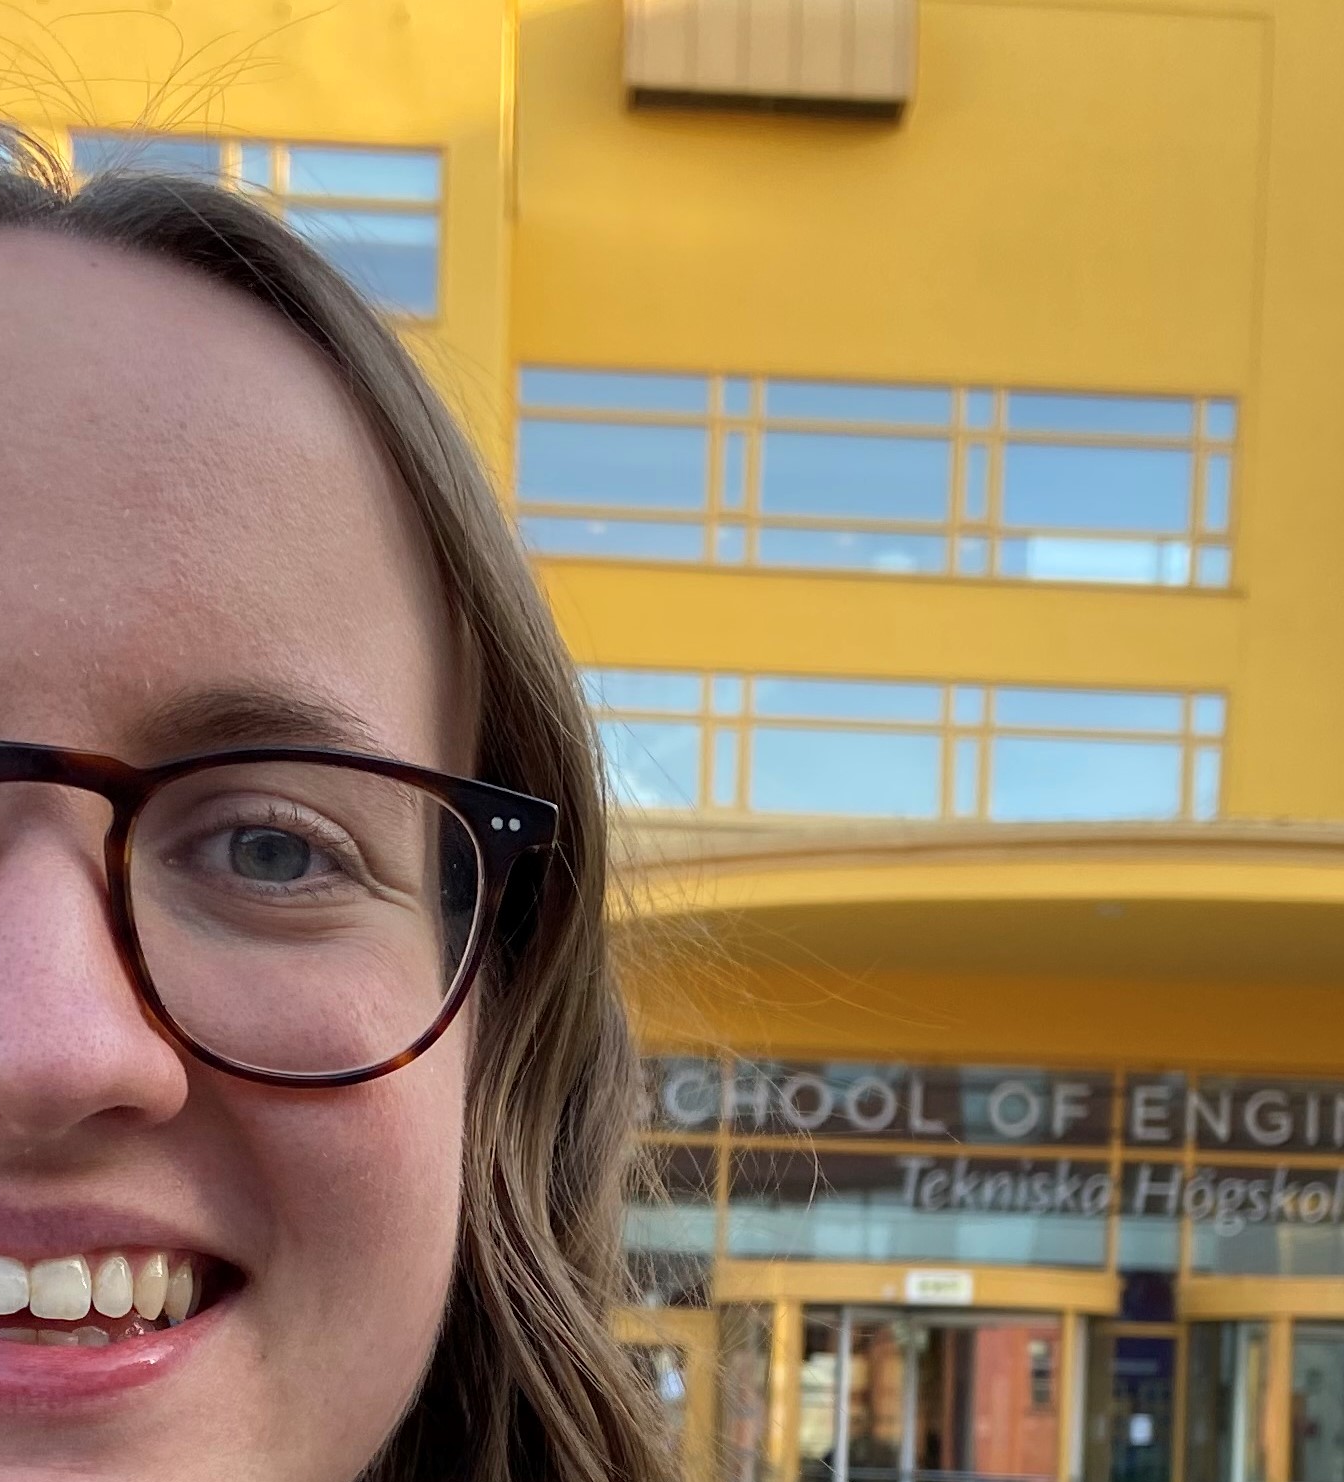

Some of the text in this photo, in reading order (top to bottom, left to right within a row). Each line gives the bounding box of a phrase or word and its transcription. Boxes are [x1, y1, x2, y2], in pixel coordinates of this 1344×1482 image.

[640, 1066, 948, 1135] CHOOL
[988, 1079, 1093, 1138] OF
[896, 1154, 1114, 1218] Tekniska
